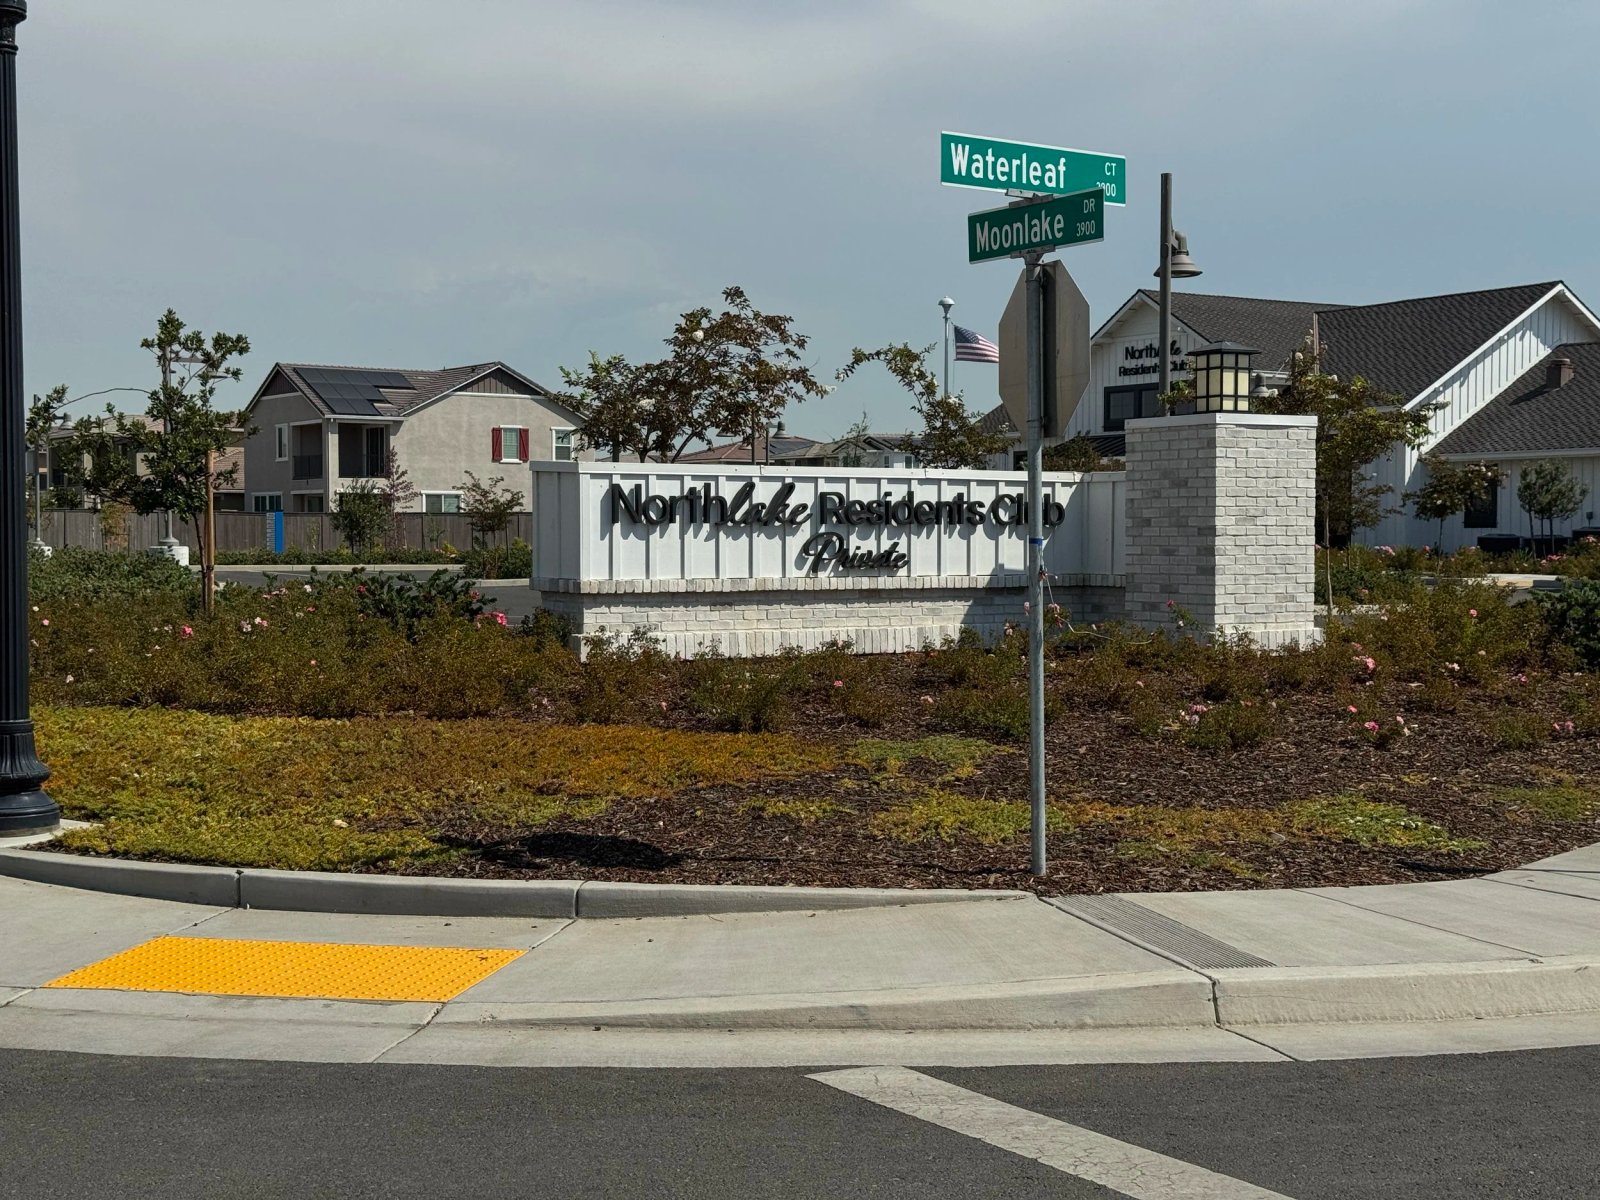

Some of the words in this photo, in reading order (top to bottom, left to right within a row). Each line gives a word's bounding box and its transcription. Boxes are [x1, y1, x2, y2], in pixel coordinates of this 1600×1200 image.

[951, 143, 1066, 188] Waterleaf
[1105, 162, 1116, 176] CT
[976, 209, 1064, 252] Moonlake
[1083, 198, 1095, 213] DR
[1076, 220, 1095, 237] 3900
[1125, 340, 1181, 360] Northke
[612, 482, 813, 526] Northlake
[819, 491, 986, 526] Residents
[992, 493, 1065, 526] Clb
[802, 531, 909, 574] Private
